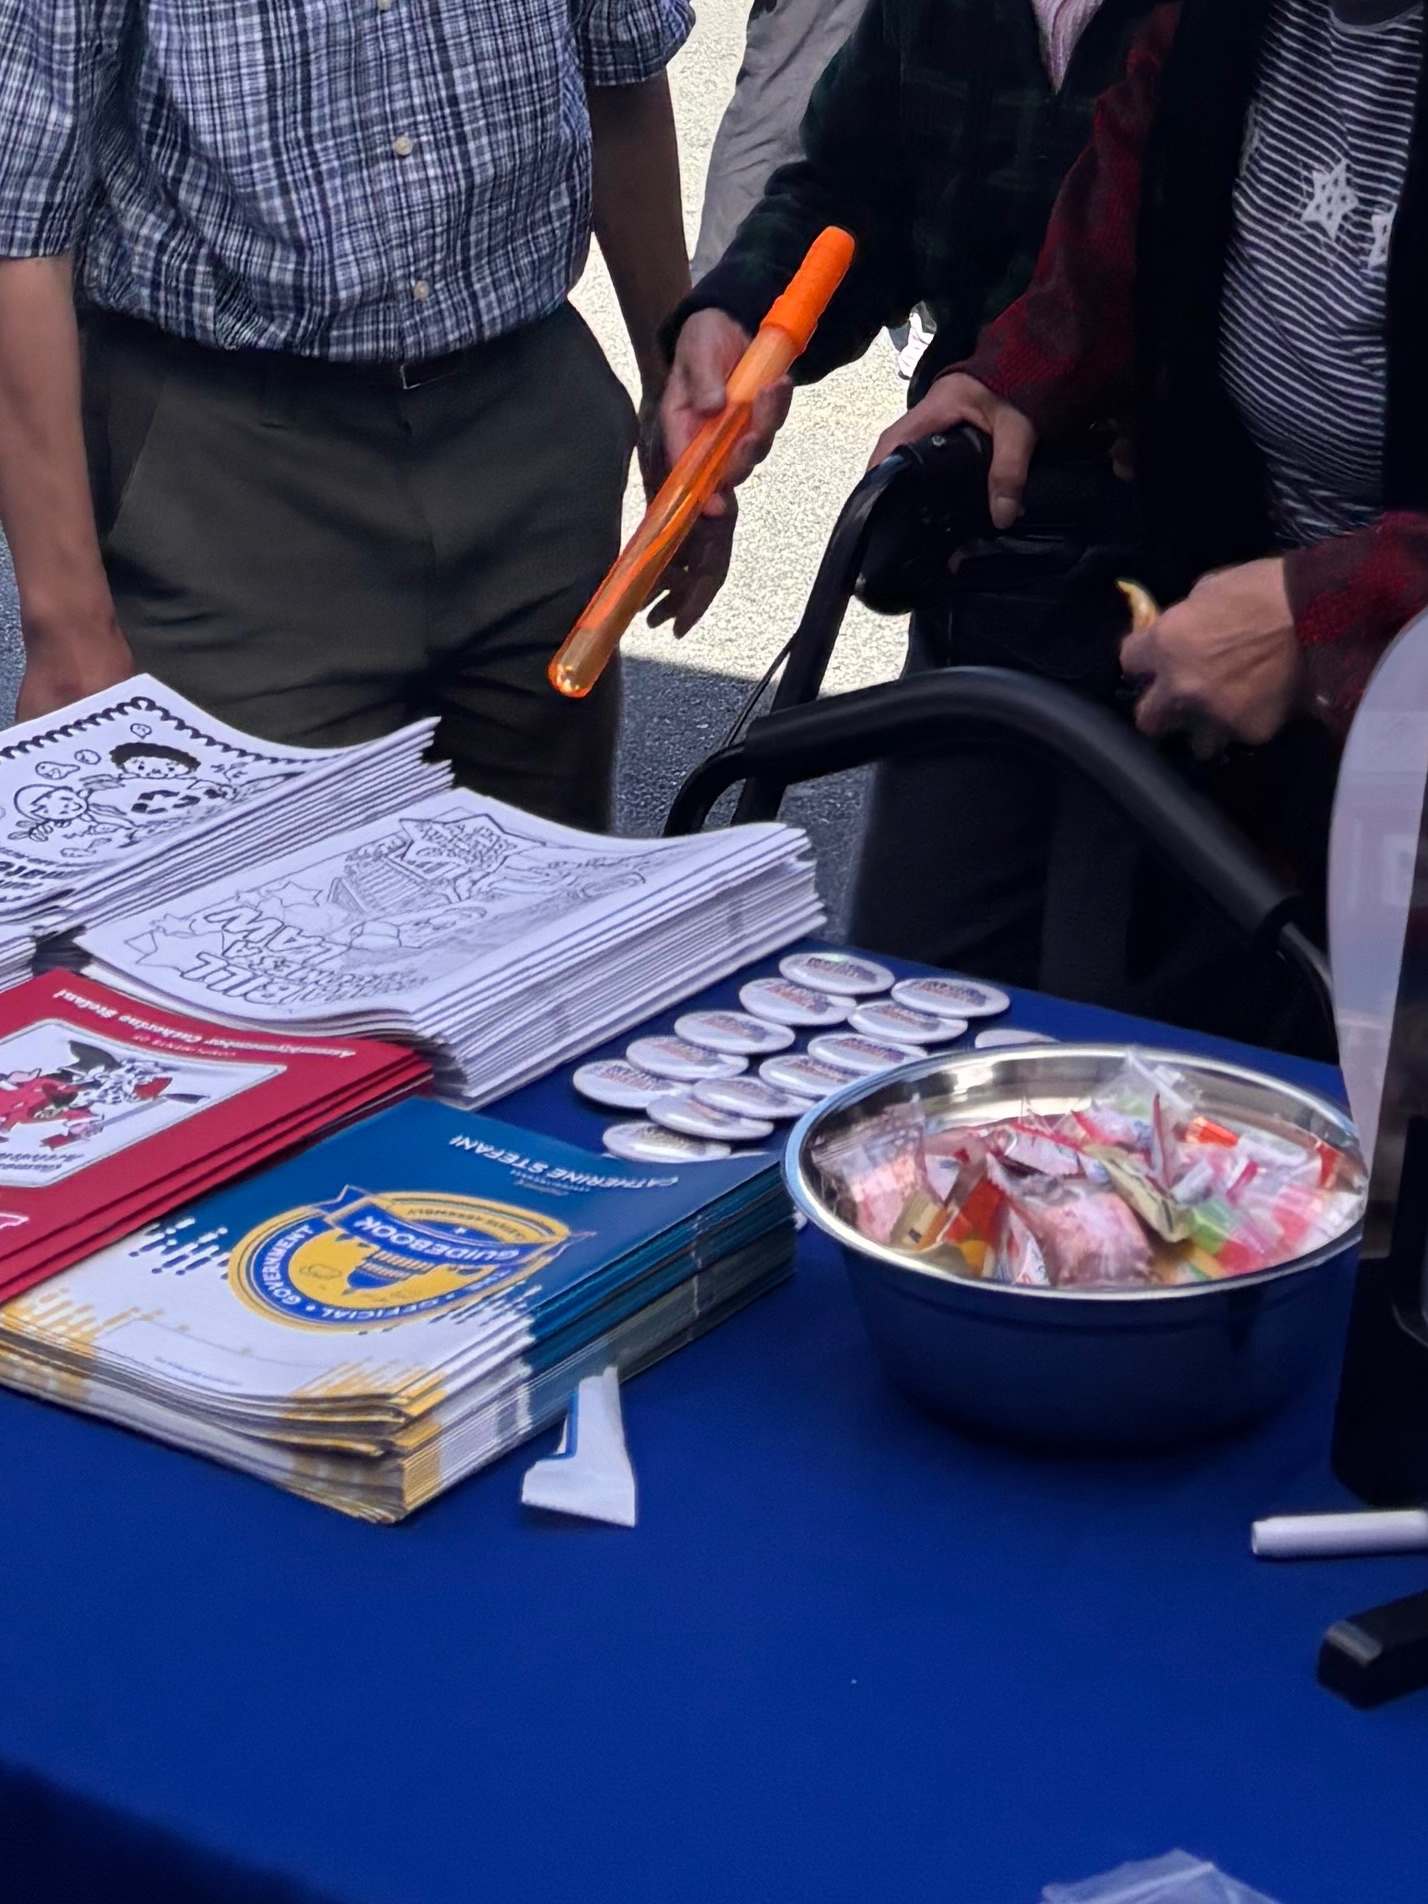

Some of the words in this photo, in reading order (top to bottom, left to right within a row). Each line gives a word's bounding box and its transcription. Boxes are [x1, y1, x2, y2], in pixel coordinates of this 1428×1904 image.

[119, 1013, 203, 1043] Catherine
[448, 1132, 549, 1174] STEFANI
[546, 1167, 679, 1189] CATHERINE
[353, 1215, 520, 1262] GUIDEBOOK
[261, 1224, 315, 1306] GOVERNMENT
[321, 1294, 448, 1320] OFFICIAL
